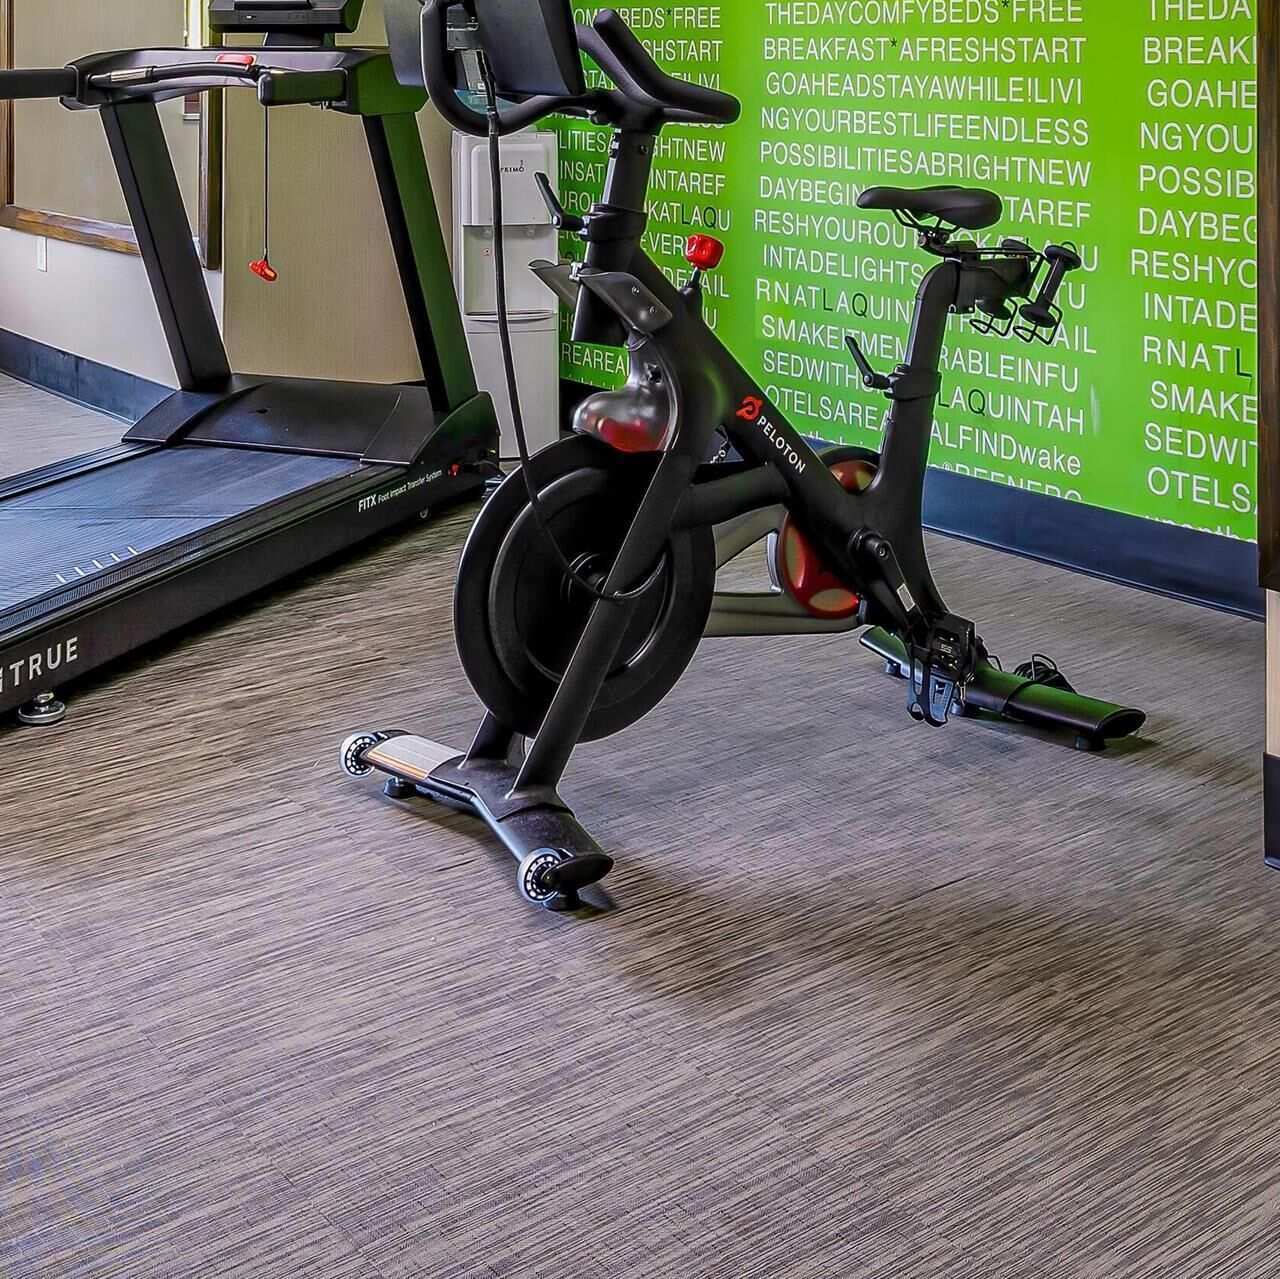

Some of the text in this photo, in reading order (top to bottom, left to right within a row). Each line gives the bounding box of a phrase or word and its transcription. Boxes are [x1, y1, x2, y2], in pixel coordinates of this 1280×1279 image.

[1144, 35, 1256, 65] BREAK
[766, 72, 1082, 104] GOAHEADSTAYAWHILE!LIVI
[761, 107, 1089, 147] NGYOURBESTLIFEENDLESS
[760, 141, 1091, 188] POSSIBILITIESABRIGHTNEW
[756, 415, 806, 474] PELOTON
[358, 494, 377, 512] FITX
[1147, 466, 1257, 514] OTELS
[9, 636, 78, 687] TRUE
